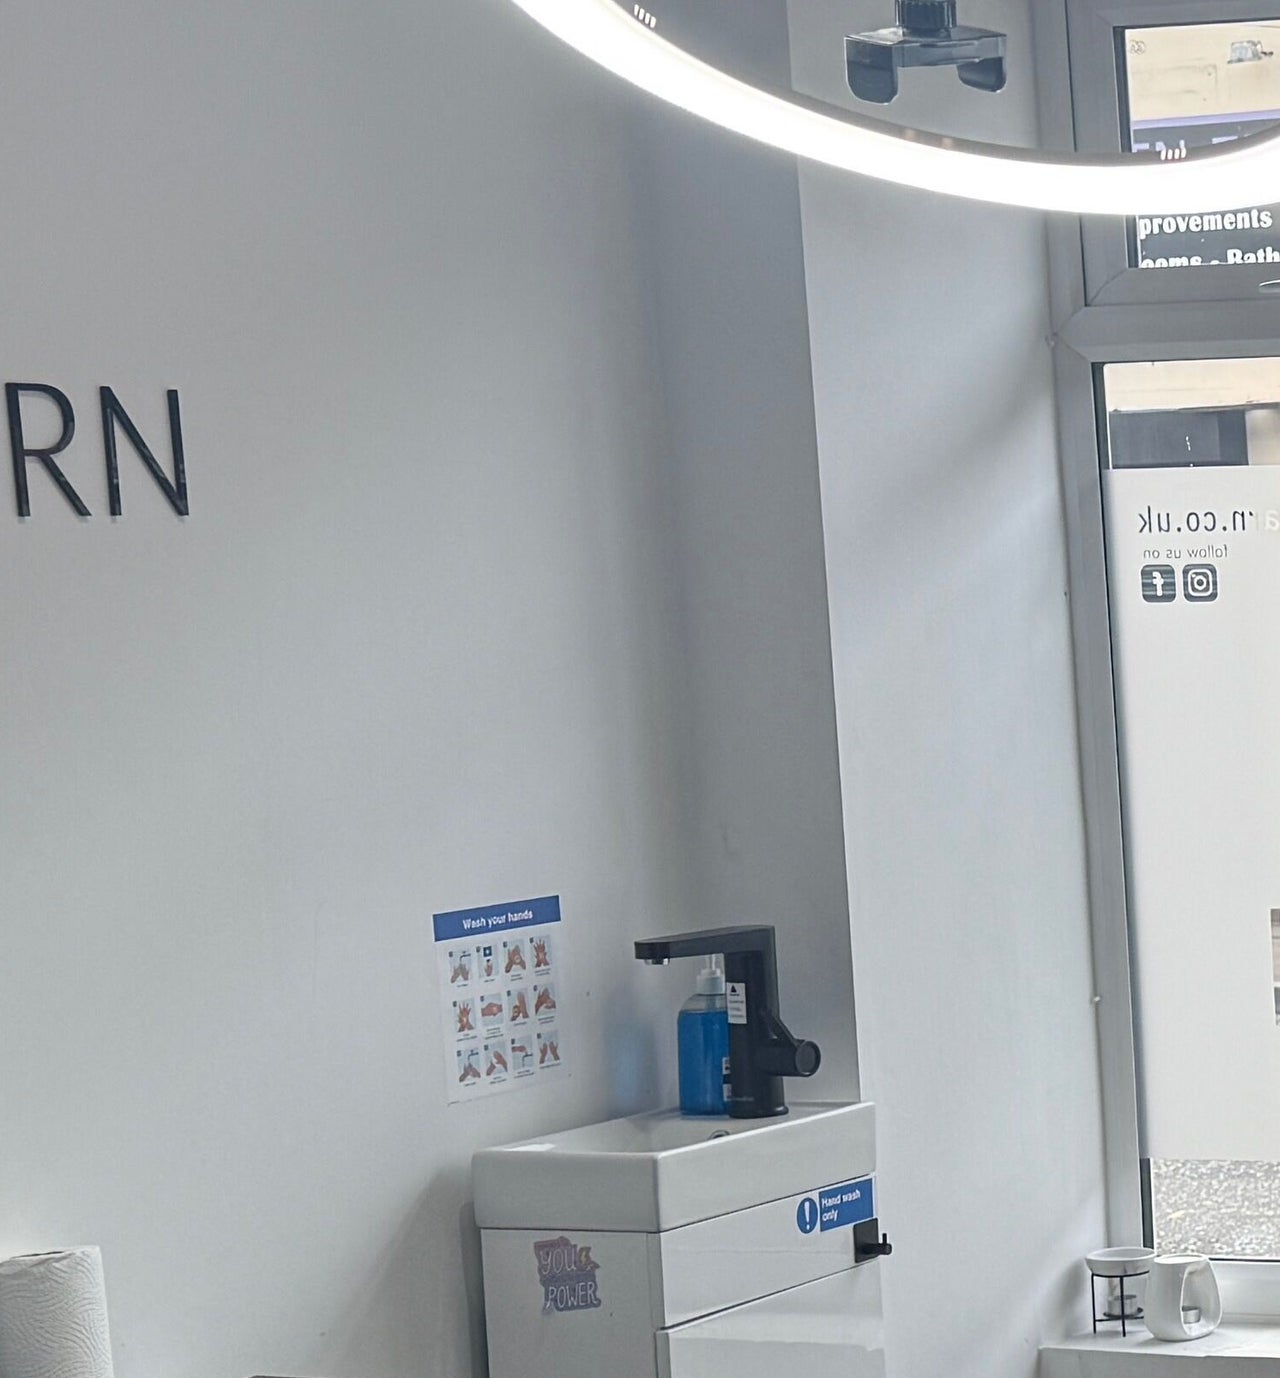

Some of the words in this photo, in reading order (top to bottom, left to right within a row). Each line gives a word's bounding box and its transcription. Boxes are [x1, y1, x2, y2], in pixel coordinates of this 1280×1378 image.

[1139, 209, 1273, 240] provements
[5, 382, 189, 517] RN
[463, 916, 486, 930] Wash
[487, 914, 506, 929] your
[508, 909, 533, 923] hands
[822, 1194, 841, 1208] Hand
[842, 1189, 861, 1203] wash
[822, 1209, 838, 1221] only
[540, 1247, 577, 1275] YOU
[546, 1281, 598, 1309] POWER
